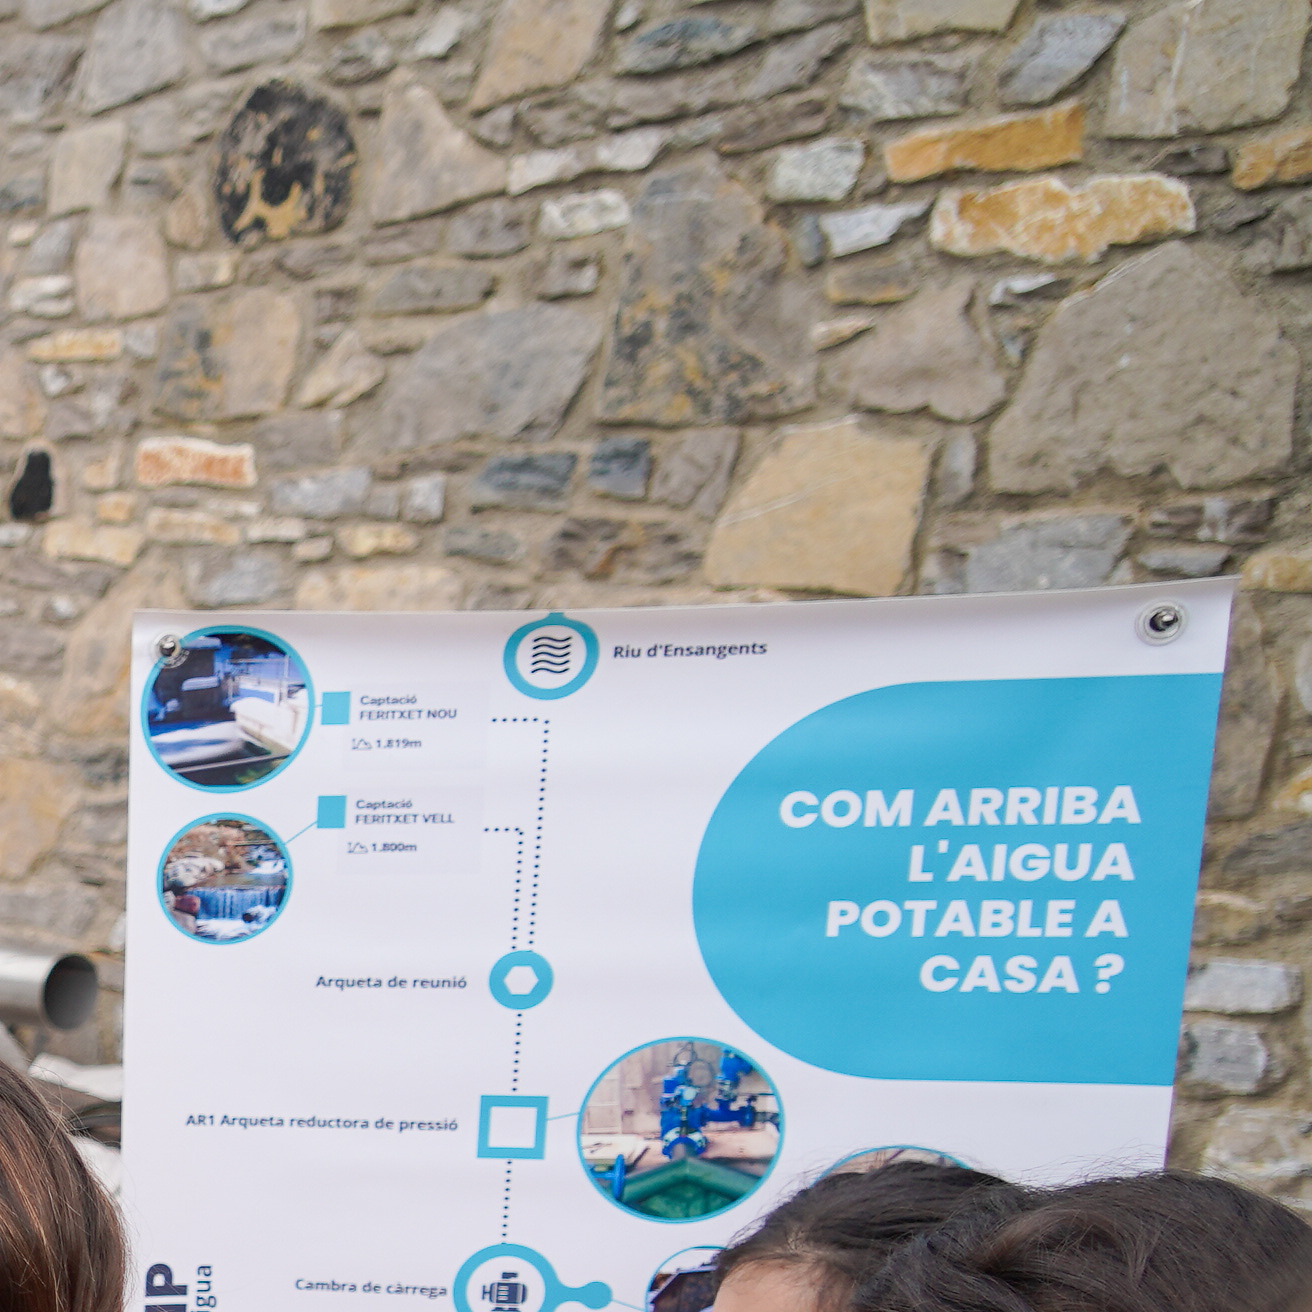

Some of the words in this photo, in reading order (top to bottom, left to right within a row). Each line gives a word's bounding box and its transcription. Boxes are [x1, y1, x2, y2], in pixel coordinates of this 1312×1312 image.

[613, 643, 641, 659] Riu
[647, 641, 768, 660] d'Ensangents
[359, 693, 418, 706] Captació
[427, 708, 458, 719] NOU
[355, 798, 413, 811] Captació
[779, 789, 915, 828] COM
[923, 785, 1142, 827] ARRIBA
[422, 813, 455, 824] VELL
[907, 839, 1136, 882] L'AIGUA
[825, 899, 1077, 938] POTABLE
[1084, 899, 1130, 938] A
[315, 975, 382, 991] Arqueta
[387, 975, 407, 988] de
[412, 975, 467, 989] reunió
[919, 954, 1080, 994] CASA
[1094, 953, 1126, 994] ?
[186, 1114, 214, 1127] AR1
[220, 1113, 284, 1129] Arqueta
[289, 1115, 369, 1129] reductora
[374, 1117, 394, 1130] de
[399, 1118, 459, 1133] pressió
[295, 1278, 357, 1293] Cambra
[362, 1281, 382, 1294] de
[386, 1282, 448, 1299] càrrega
